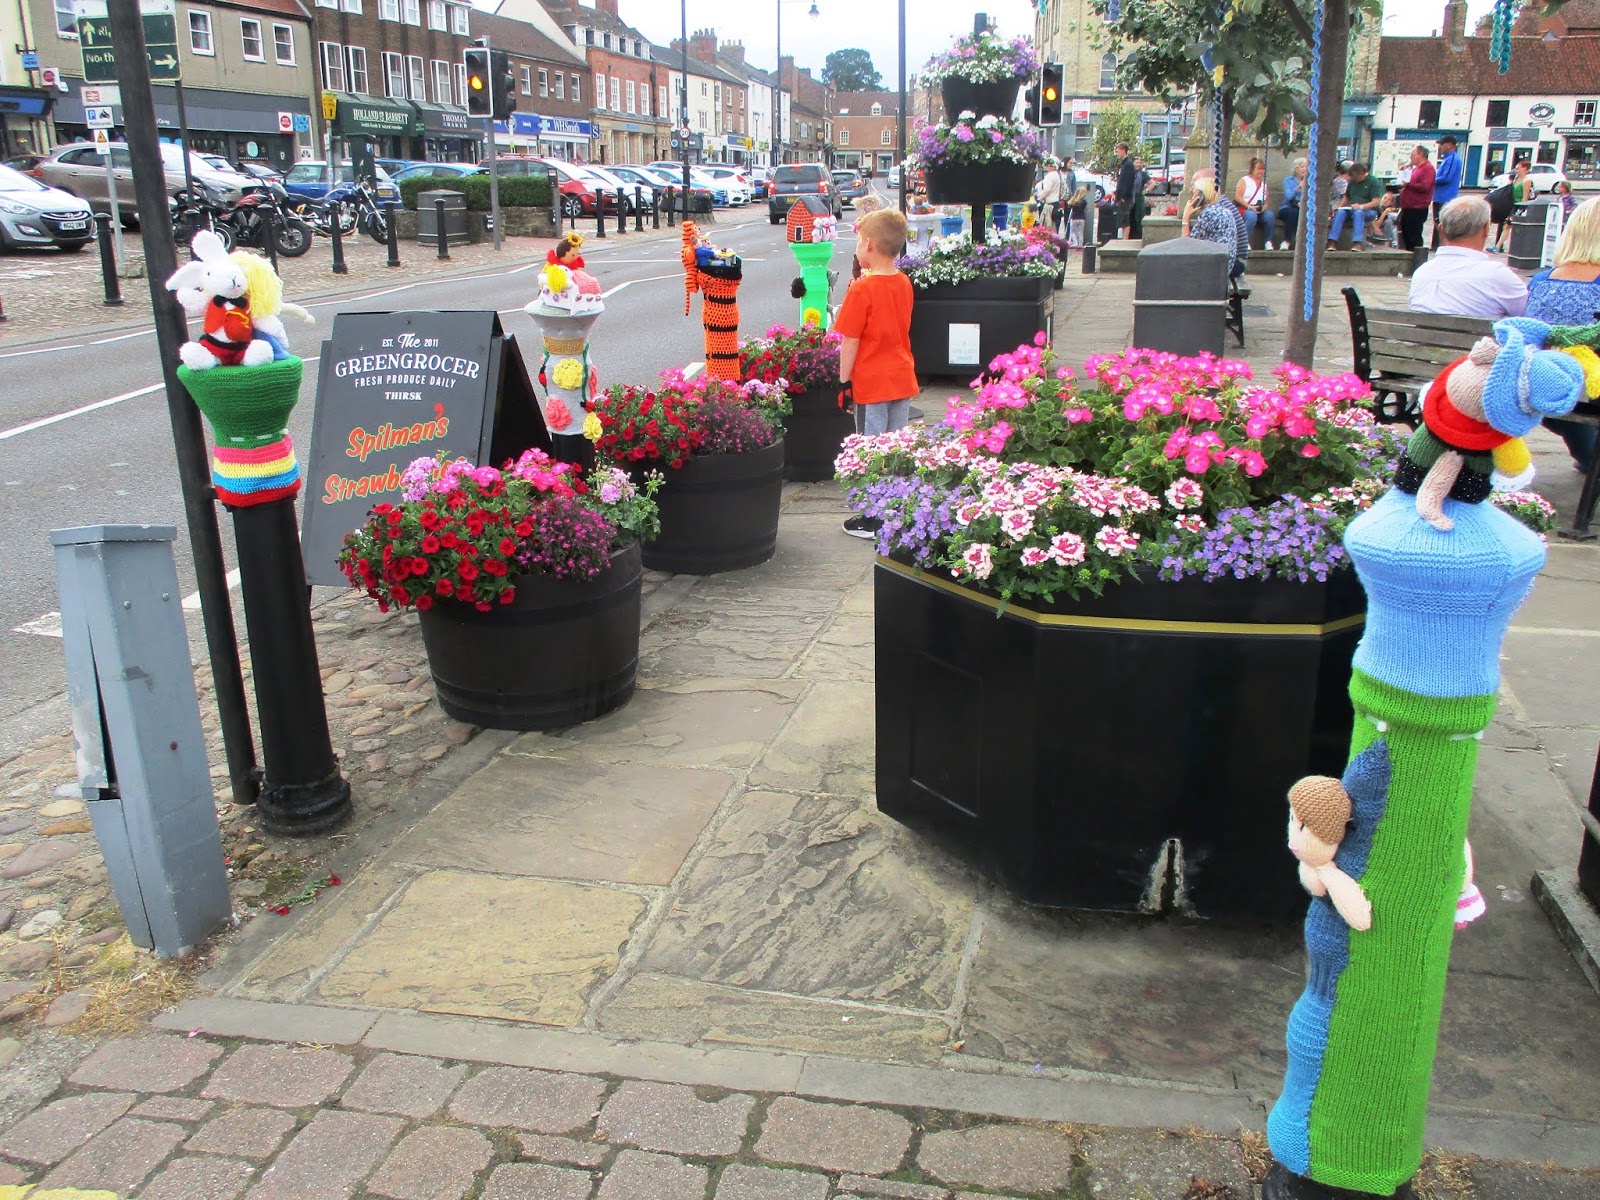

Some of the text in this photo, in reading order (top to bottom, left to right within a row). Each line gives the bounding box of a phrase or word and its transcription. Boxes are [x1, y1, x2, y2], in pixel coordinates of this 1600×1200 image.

[352, 108, 379, 121] HOLLAND
[441, 113, 467, 124] THOMAS
[553, 119, 581, 134] WHSmith
[681, 129, 689, 137] 20
[382, 332, 439, 349] EST. The 2011
[335, 352, 480, 379] GREENGROCER
[355, 374, 457, 389] FRESH PRODUCE DAILY
[385, 391, 422, 400] THIRSK
[345, 402, 450, 462] Spilman's
